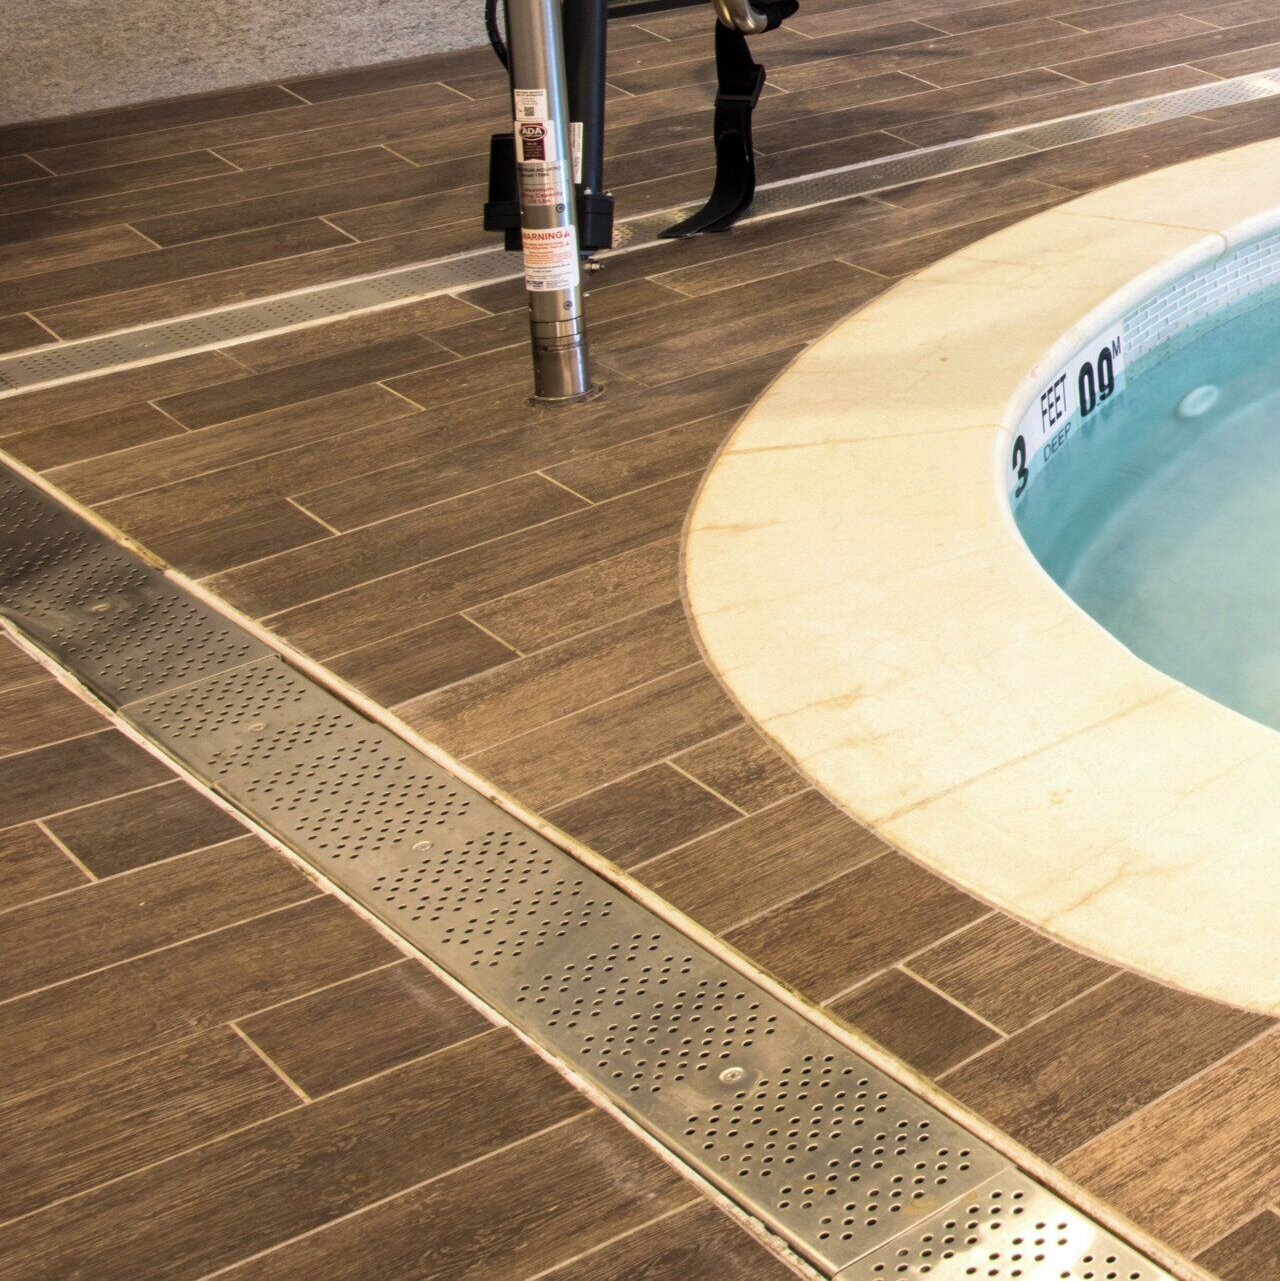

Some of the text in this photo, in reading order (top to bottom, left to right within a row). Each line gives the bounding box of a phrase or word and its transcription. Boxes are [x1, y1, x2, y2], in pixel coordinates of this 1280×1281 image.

[522, 127, 542, 135] ADA
[1012, 434, 1029, 499] 3
[1040, 372, 1067, 434] FEET
[1043, 421, 1072, 462] DEEP
